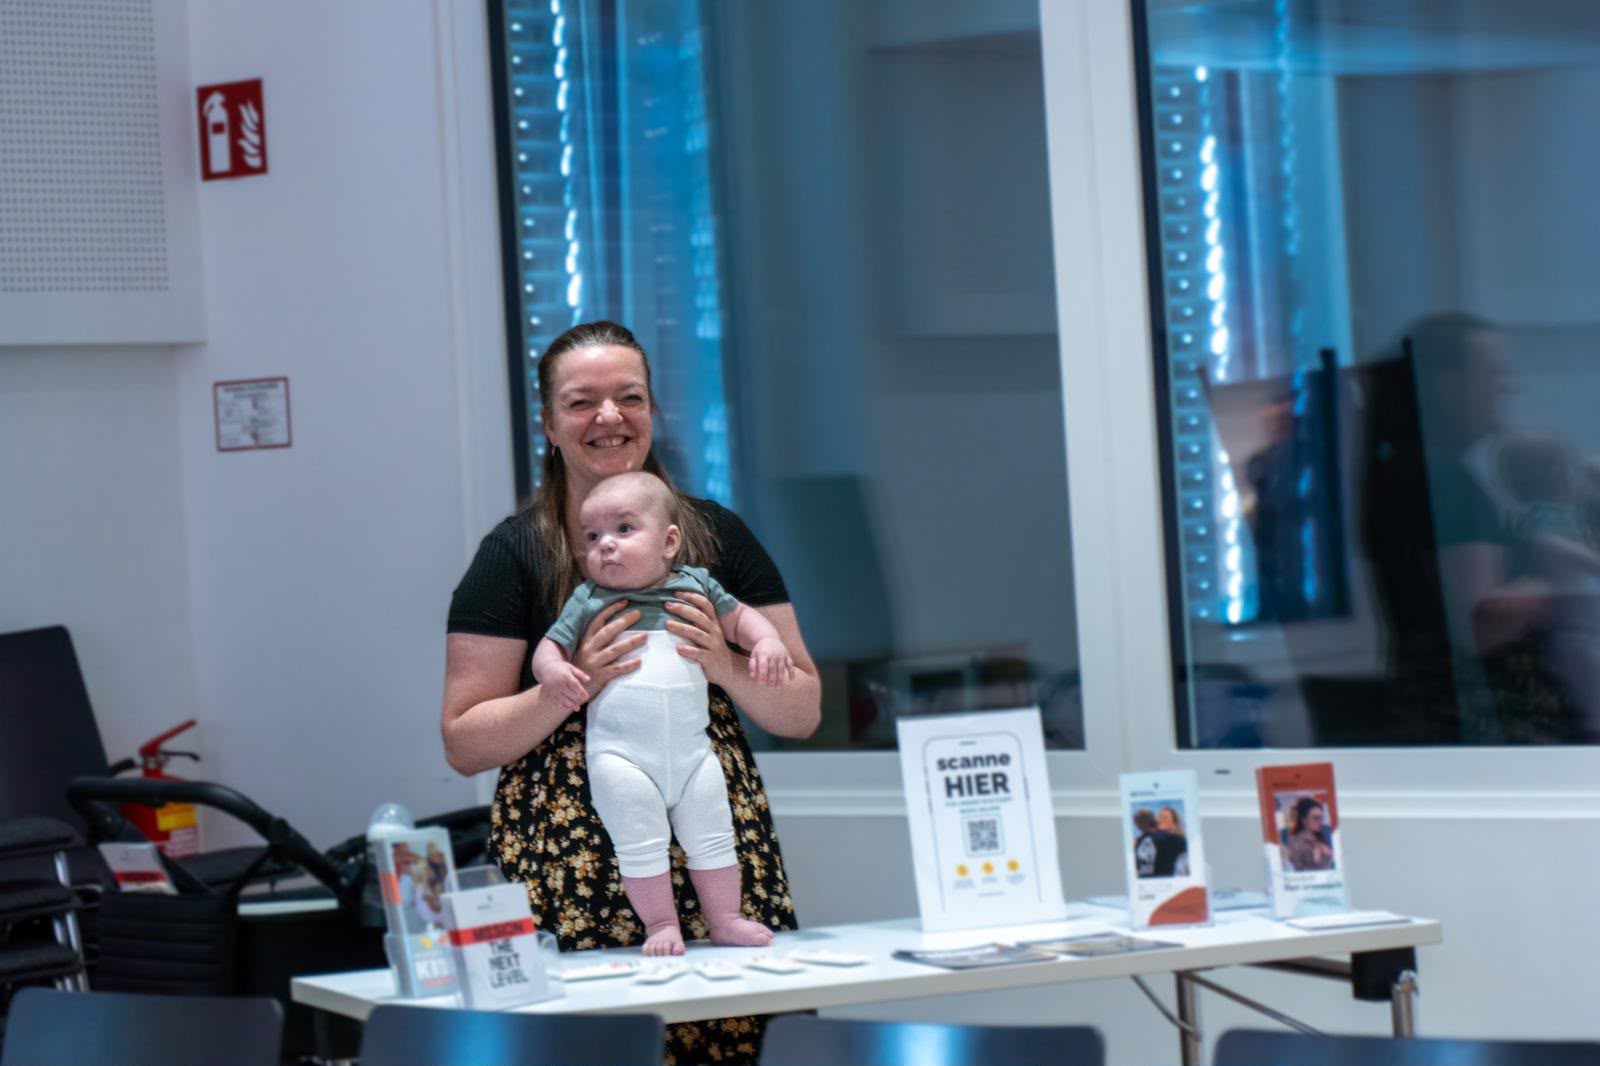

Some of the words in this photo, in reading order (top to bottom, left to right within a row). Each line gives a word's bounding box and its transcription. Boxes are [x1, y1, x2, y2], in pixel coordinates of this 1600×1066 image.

[937, 752, 1010, 771] scanne
[944, 772, 1010, 798] HIER
[490, 939, 513, 956] THE
[489, 953, 519, 971] NEXT
[489, 969, 528, 989] LEVEL
